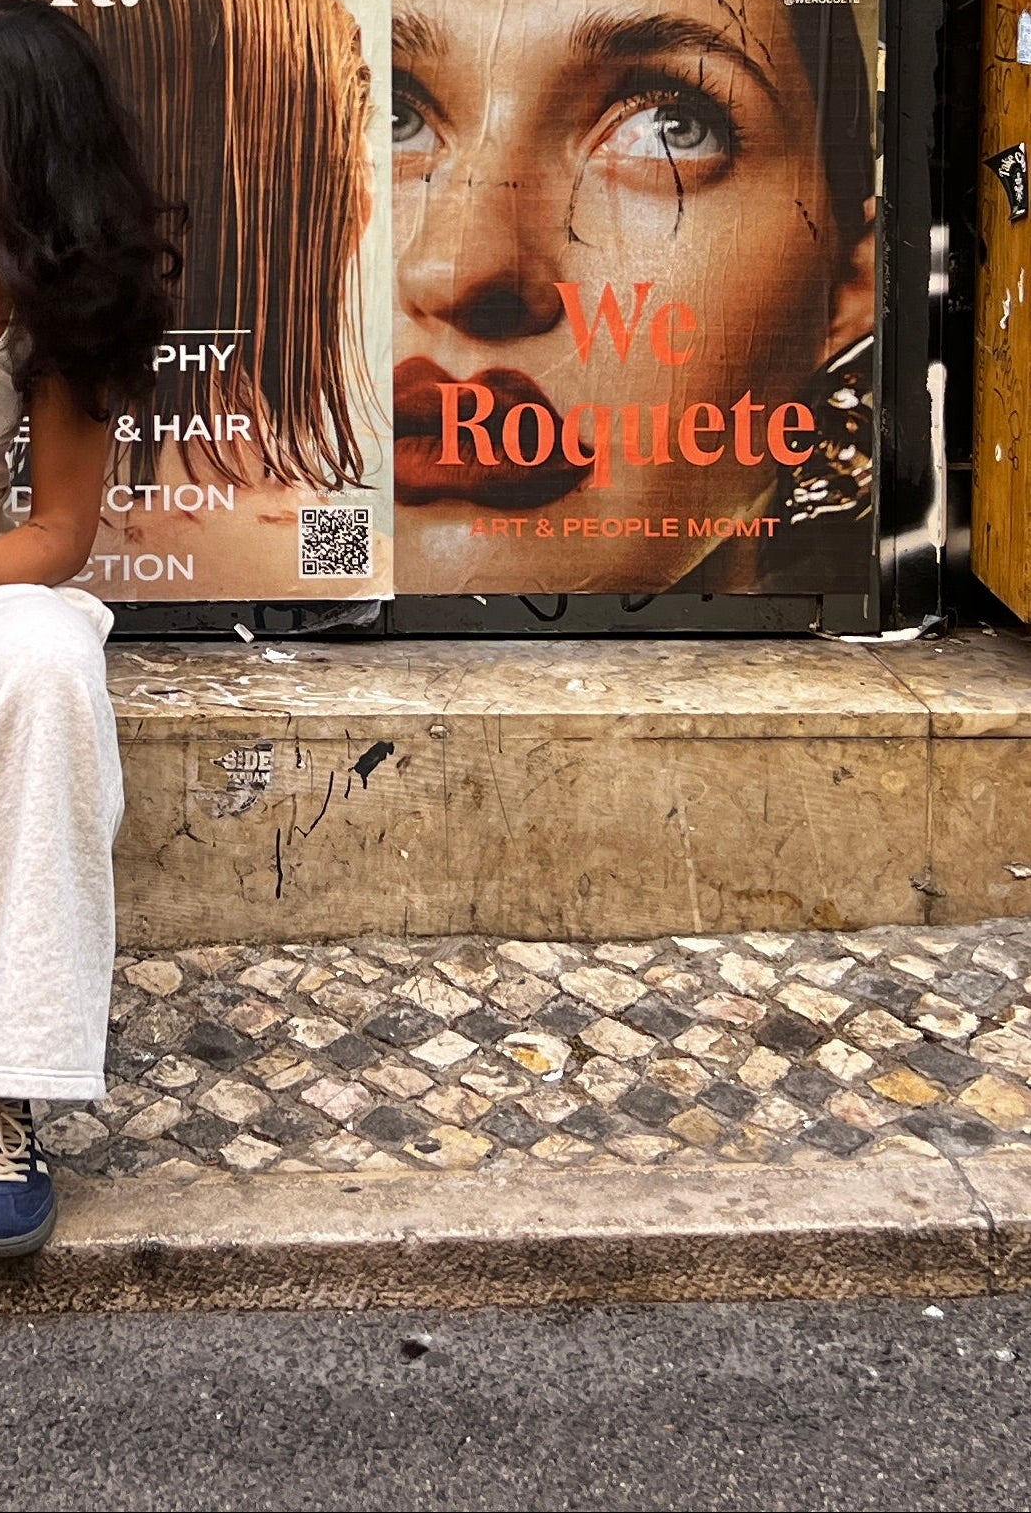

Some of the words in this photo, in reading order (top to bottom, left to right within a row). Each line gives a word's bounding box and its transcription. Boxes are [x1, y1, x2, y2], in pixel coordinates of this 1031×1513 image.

[554, 281, 696, 365] We
[115, 415, 141, 441] &
[153, 415, 251, 441] HAIR
[435, 382, 816, 489] Roquete
[472, 518, 527, 538] ART
[535, 518, 555, 537] &
[564, 517, 679, 537] PEOPLE
[688, 517, 781, 537] MGMT
